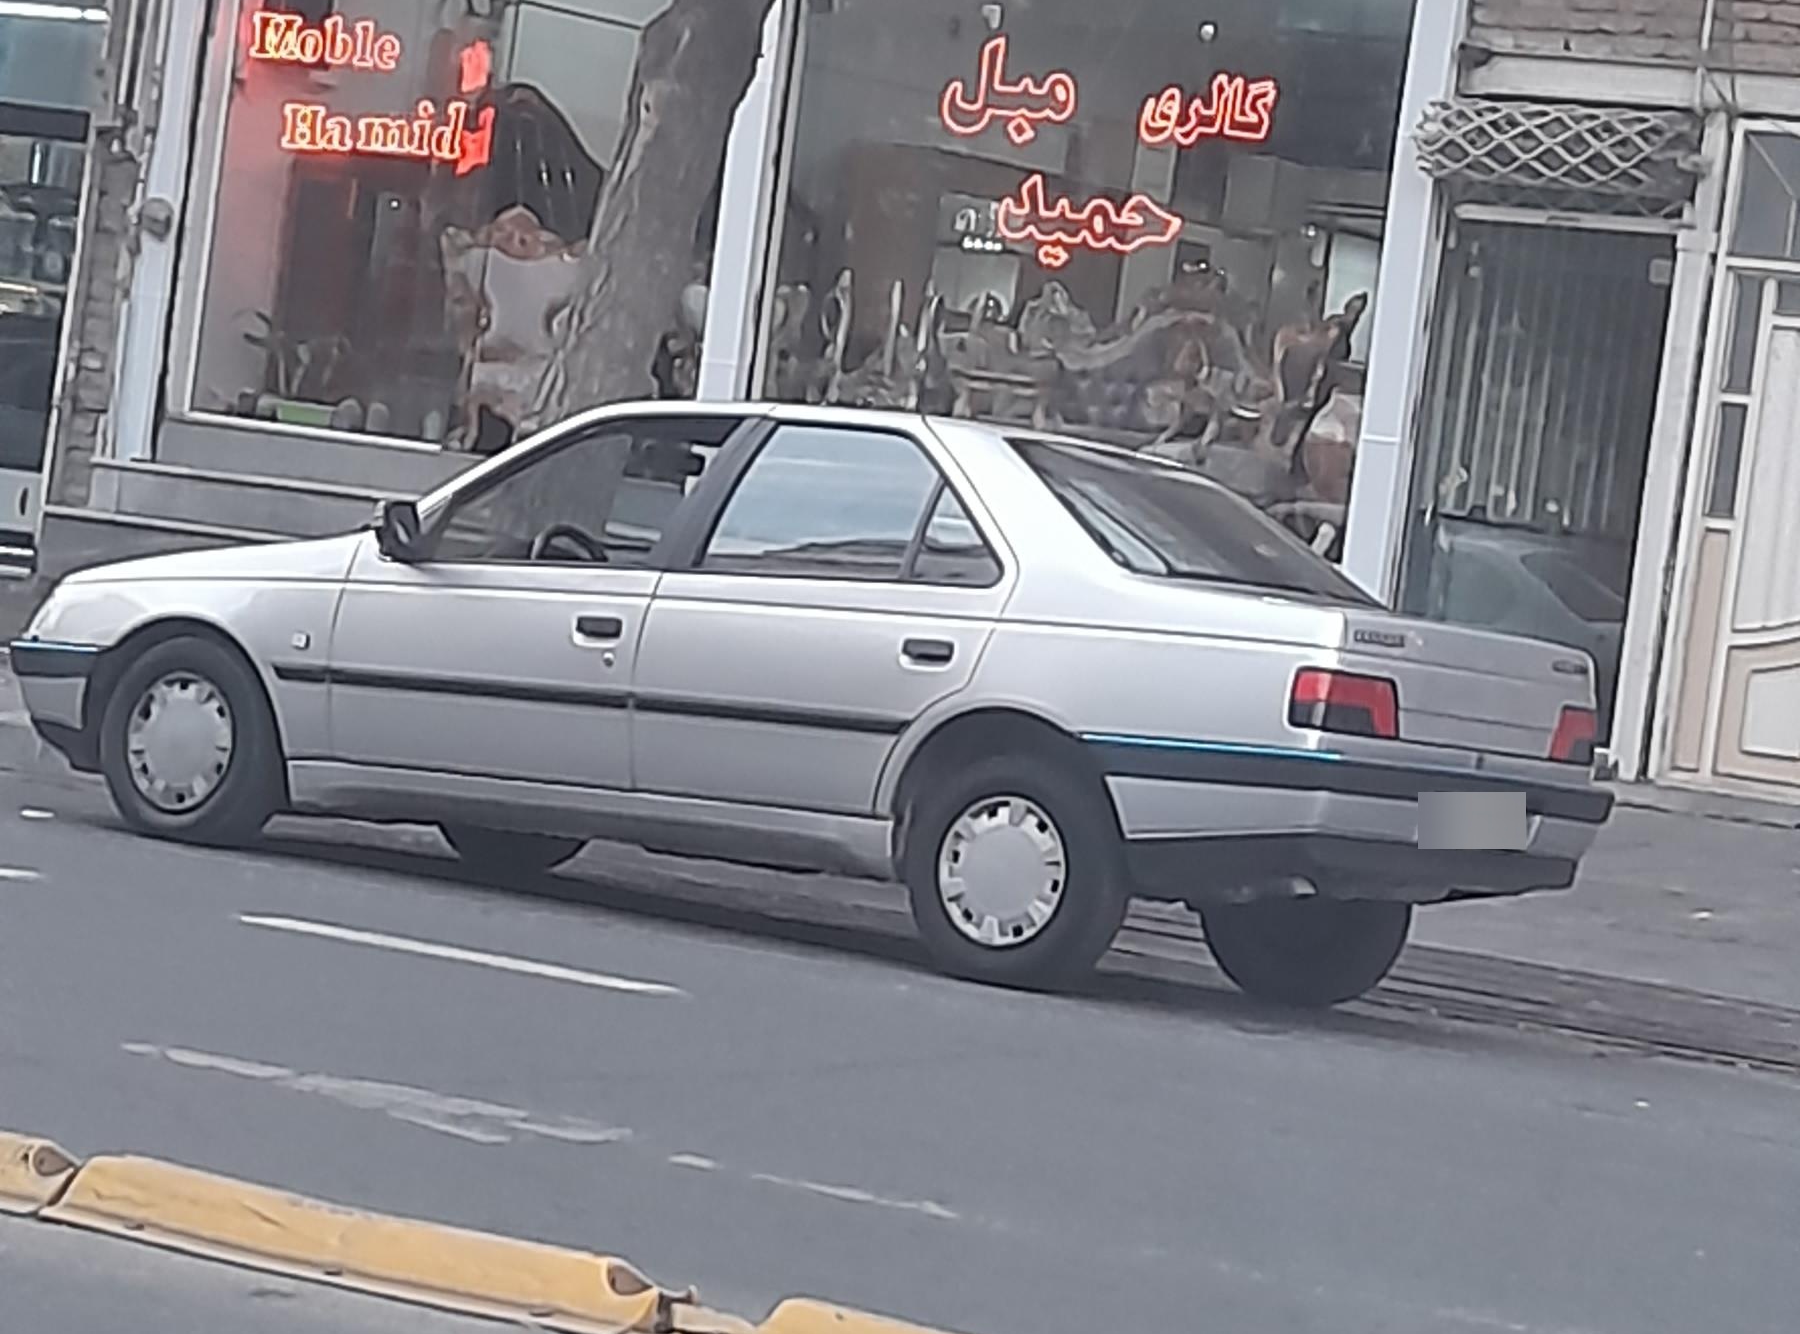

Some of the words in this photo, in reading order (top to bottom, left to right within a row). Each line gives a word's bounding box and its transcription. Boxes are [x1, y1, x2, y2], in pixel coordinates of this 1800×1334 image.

[250, 11, 401, 69] Moble
[941, 34, 1077, 145] مبل
[1138, 71, 1278, 146] گالری
[280, 100, 468, 159] Hamid
[998, 172, 1183, 267] حمید
